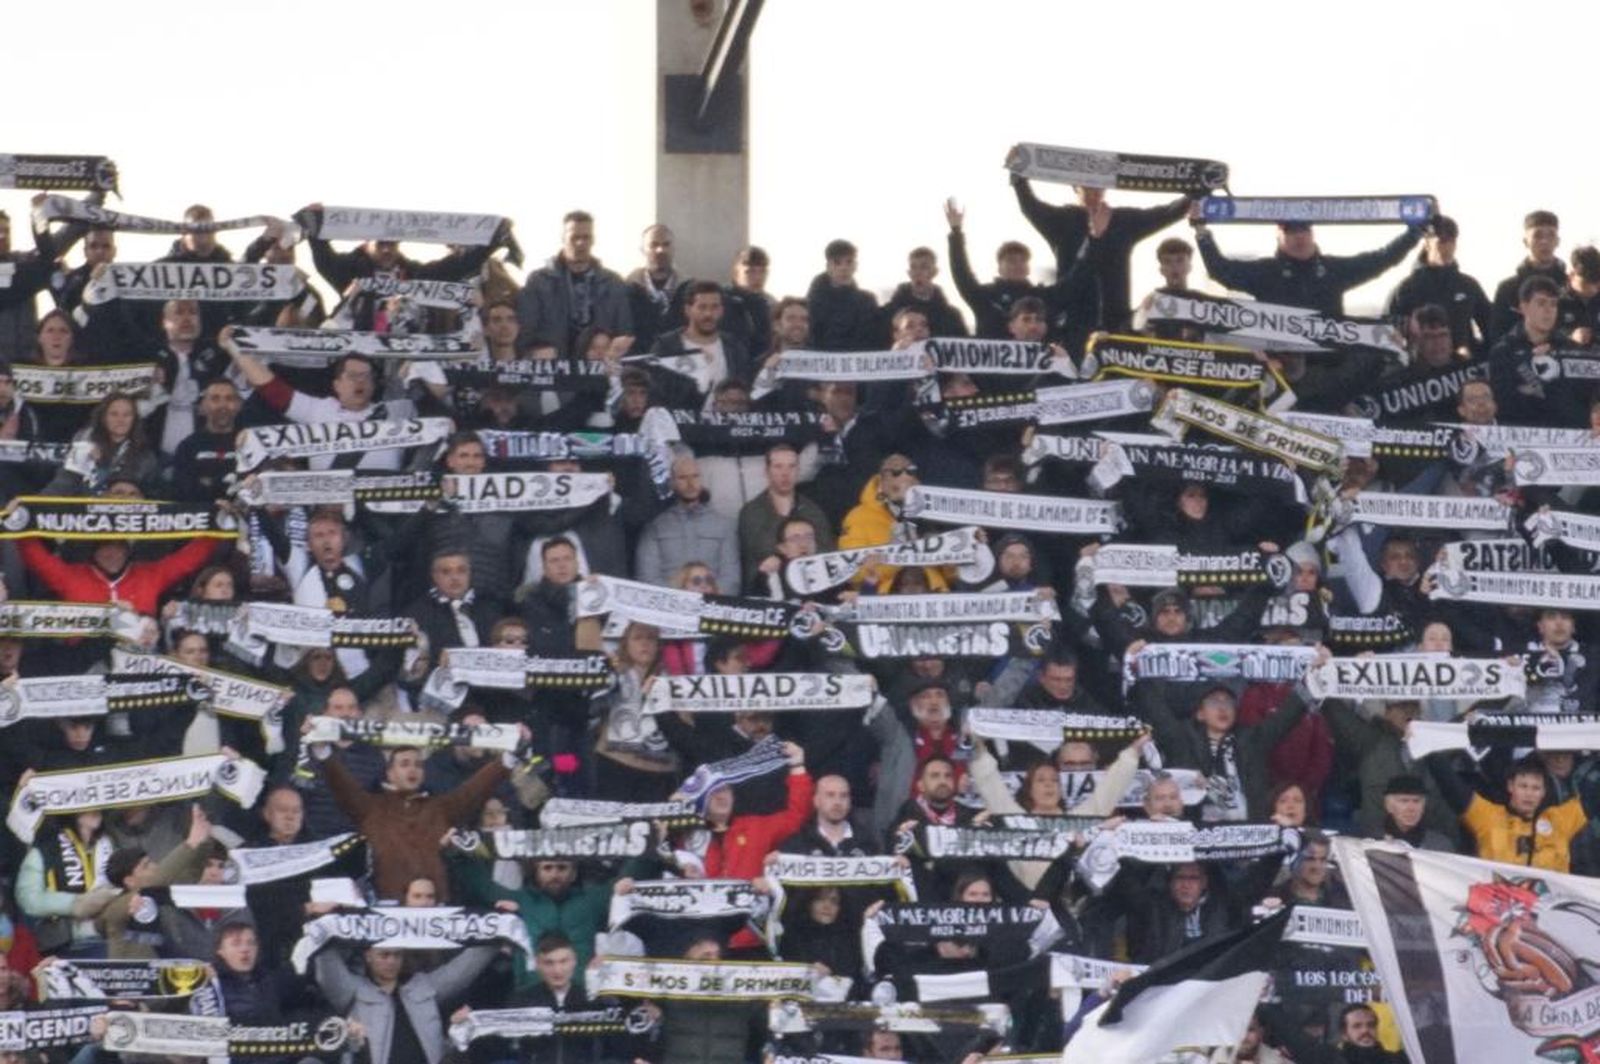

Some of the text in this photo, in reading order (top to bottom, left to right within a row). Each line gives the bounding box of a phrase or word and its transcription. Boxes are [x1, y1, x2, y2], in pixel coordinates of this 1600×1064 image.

[1190, 302, 1360, 344] UNIONISTAS
[1101, 349, 1264, 380] NUNCA SE RINDE
[1235, 419, 1258, 439] DE
[1130, 447, 1149, 463] IN
[1154, 449, 1254, 475] MEMORIAM
[450, 475, 572, 501] LIADOS
[1001, 500, 1014, 518] DE
[1017, 501, 1082, 522] SALAMANCA
[1427, 503, 1440, 519] DE
[36, 512, 210, 532] NUNCA SE RINDE
[1569, 522, 1600, 539] UNION
[1549, 580, 1563, 599] DE
[943, 598, 1006, 617] SALAMANCA
[336, 913, 500, 938] UNIONISTAS
[898, 906, 1004, 926] MEMORIAM
[1307, 915, 1365, 936] UNIONIST
[699, 974, 723, 991] DE
